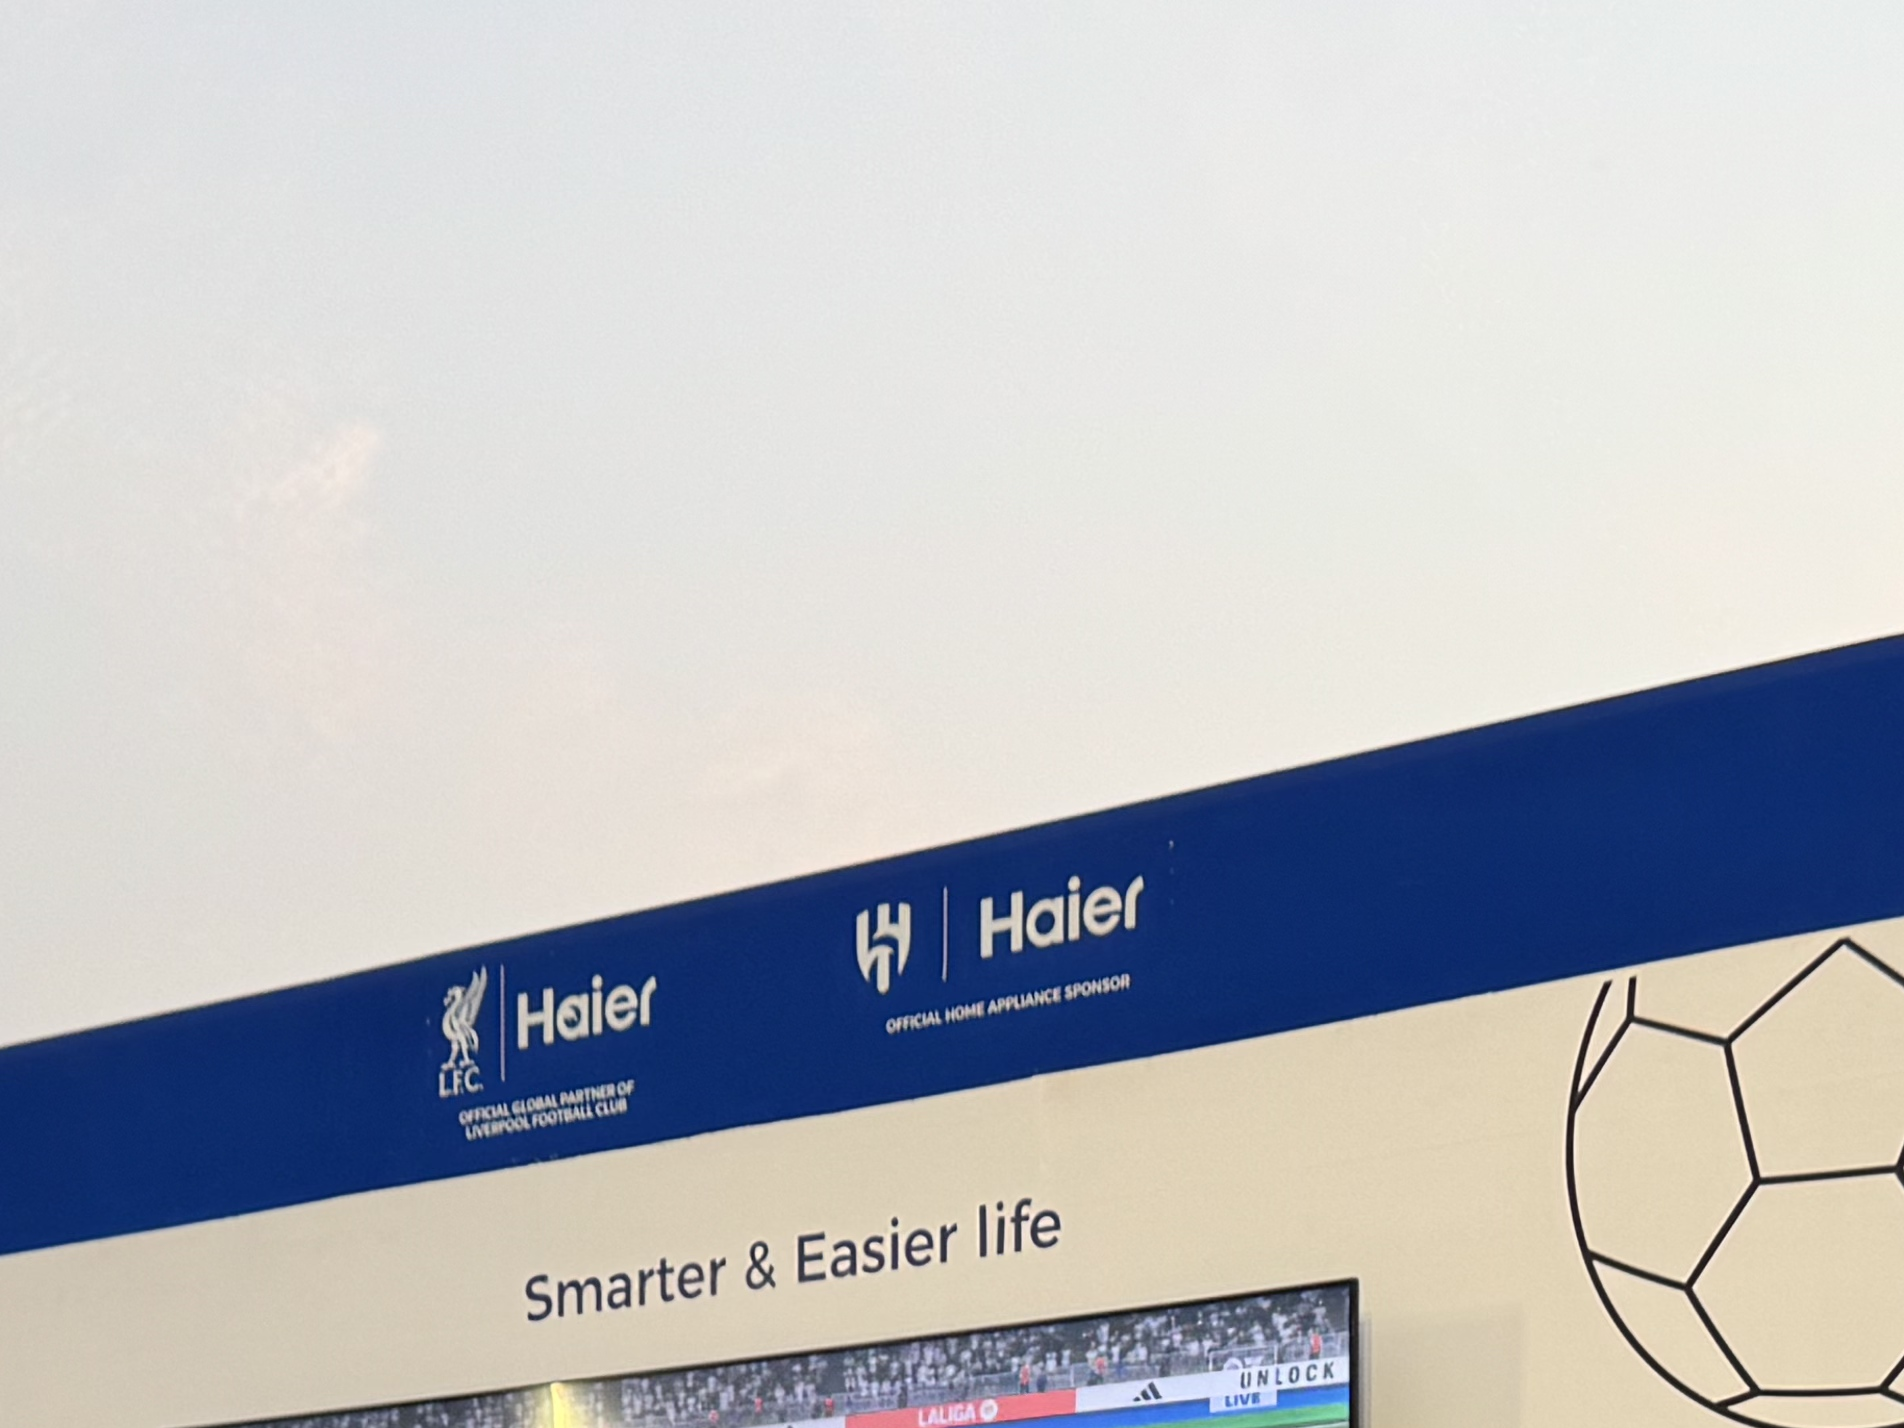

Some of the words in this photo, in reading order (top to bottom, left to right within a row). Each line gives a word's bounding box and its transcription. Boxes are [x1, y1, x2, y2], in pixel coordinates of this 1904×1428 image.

[980, 875, 1145, 959] Haier
[517, 974, 657, 1051] Haier
[885, 1009, 942, 1034] OFFICIAL
[945, 1001, 985, 1022] HOME
[987, 986, 1062, 1015] APPLIANCE
[1064, 973, 1131, 1000] SPONSOR
[458, 1103, 510, 1127] OFFICIAL
[511, 1093, 557, 1116] GLOBAL
[559, 1083, 615, 1106] PARTNER
[616, 1079, 635, 1097] OF
[465, 1115, 531, 1141] LIVERPOOL
[532, 1105, 593, 1129] FOOTBALL
[595, 1097, 628, 1117] CLUB
[525, 1256, 727, 1322] Smarter
[745, 1240, 776, 1290] &
[797, 1216, 958, 1283] Easier
[978, 1197, 1062, 1258] life
[1240, 1362, 1334, 1389] UNLOCK
[918, 1403, 976, 1428] LALIGA
